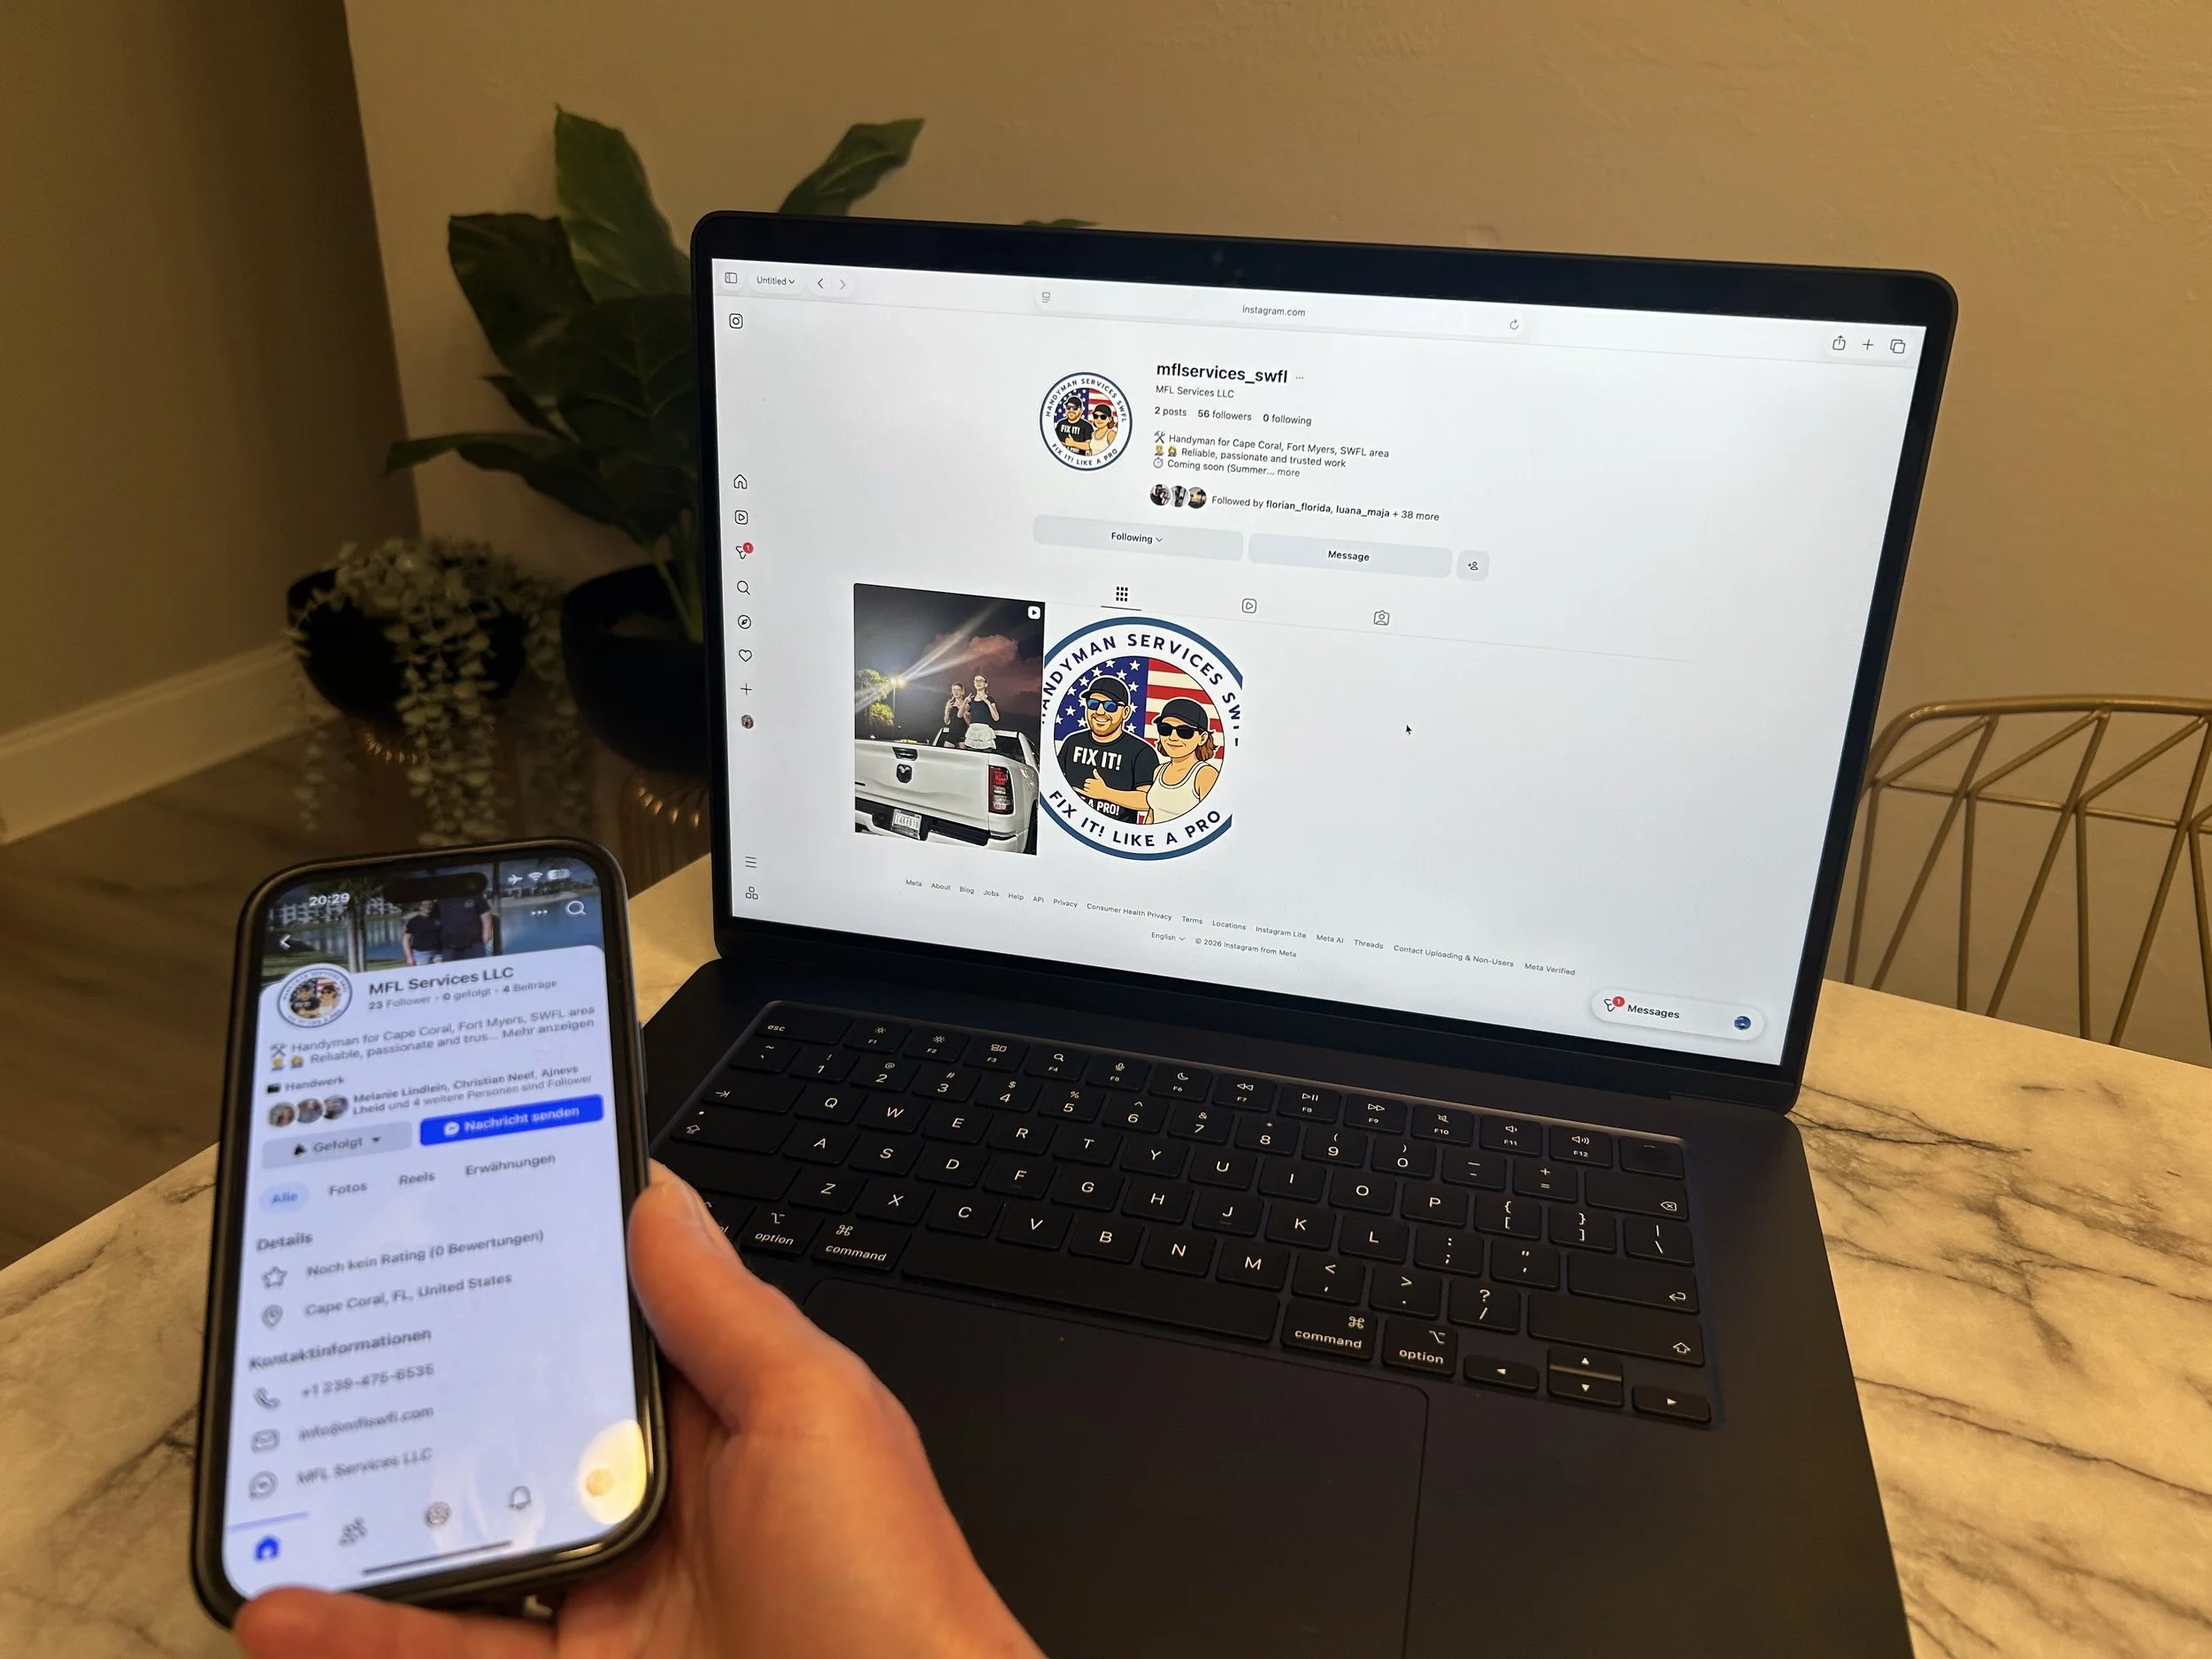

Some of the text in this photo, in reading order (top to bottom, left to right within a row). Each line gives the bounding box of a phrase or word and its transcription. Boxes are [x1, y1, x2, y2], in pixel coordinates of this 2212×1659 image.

[757, 276, 787, 285] Untitled
[1242, 304, 1305, 316] instagram.com
[1157, 363, 1287, 384] mflservices_swfl
[1156, 385, 1233, 398] MFL Services LLC
[1046, 379, 1126, 422] HANDYMAN SERVICES SWFL
[1198, 409, 1210, 418] 56
[1212, 410, 1251, 420] followers
[1263, 413, 1269, 422] 0
[1271, 414, 1311, 426] following
[1169, 434, 1215, 445] Handyman
[1217, 437, 1230, 446] for
[1233, 438, 1256, 449] Cape
[1258, 440, 1283, 452] Coral,
[1286, 442, 1304, 451] Fort
[1308, 444, 1336, 456] Myers,
[1340, 446, 1366, 456] SWFL
[1181, 448, 1217, 459] Reliable,
[1220, 451, 1268, 462] passionate
[1290, 457, 1322, 465] trusted
[1325, 458, 1346, 467] work
[1167, 459, 1200, 471] Coming
[1227, 464, 1274, 475] (Summer...
[1212, 495, 1250, 506] Followed
[1253, 499, 1263, 509] by
[1266, 499, 1333, 514] florian_florida,
[1336, 505, 1389, 518] luana_maja
[1401, 510, 1413, 518] 38
[1111, 532, 1152, 544] Following
[1328, 550, 1369, 562] Message
[1042, 636, 1116, 724] ANDYMAN
[1127, 634, 1223, 685] SERVICES
[1073, 746, 1122, 771] FIX IT!
[1049, 790, 1220, 846] FIX IT! LIKE A PRO
[308, 893, 349, 908] 20:29
[959, 886, 974, 895] Blog
[1053, 898, 1078, 909] Privacy
[1087, 902, 1121, 913] Consumer
[1147, 910, 1171, 921] Privacy
[1212, 919, 1246, 930] Locations
[1256, 926, 1291, 936] Instagram
[1354, 939, 1383, 949] Threads
[1394, 945, 1423, 955] Contact
[1425, 949, 1463, 961] Uploading
[1472, 956, 1513, 967] Non-Users
[1546, 965, 1575, 975] Verified
[1151, 932, 1175, 941] English
[1224, 941, 1258, 952] Instagram
[369, 966, 513, 995] MFL Services LLC
[1627, 1004, 1679, 1018] Messages
[291, 1006, 595, 1052] Handyman for Cape Coral, Fort Myers, SWFL area
[825, 1097, 837, 1108] Q
[887, 1107, 903, 1118] W
[464, 1108, 580, 1132] Nachricht senden
[952, 1118, 964, 1127] E
[1016, 1128, 1028, 1138] R
[1084, 1138, 1094, 1148] T
[1151, 1149, 1161, 1160] Y
[465, 1155, 556, 1176] Erwähnungen
[1217, 1161, 1229, 1171] U
[398, 1171, 435, 1185] Reels
[1290, 1173, 1294, 1183] I
[328, 1182, 367, 1195] Fotos
[820, 1183, 835, 1194] Z
[1356, 1185, 1369, 1195] O
[888, 1194, 903, 1206] X
[1430, 1197, 1440, 1207] P
[958, 1207, 972, 1217] C
[1031, 1217, 1042, 1230] V
[256, 1233, 313, 1251] Details
[755, 1233, 793, 1245] option
[1099, 1231, 1112, 1242] B
[826, 1246, 887, 1261] command
[1171, 1243, 1186, 1256] N
[1245, 1256, 1261, 1270] M
[1294, 1328, 1363, 1348] command
[1399, 1349, 1443, 1363] option
